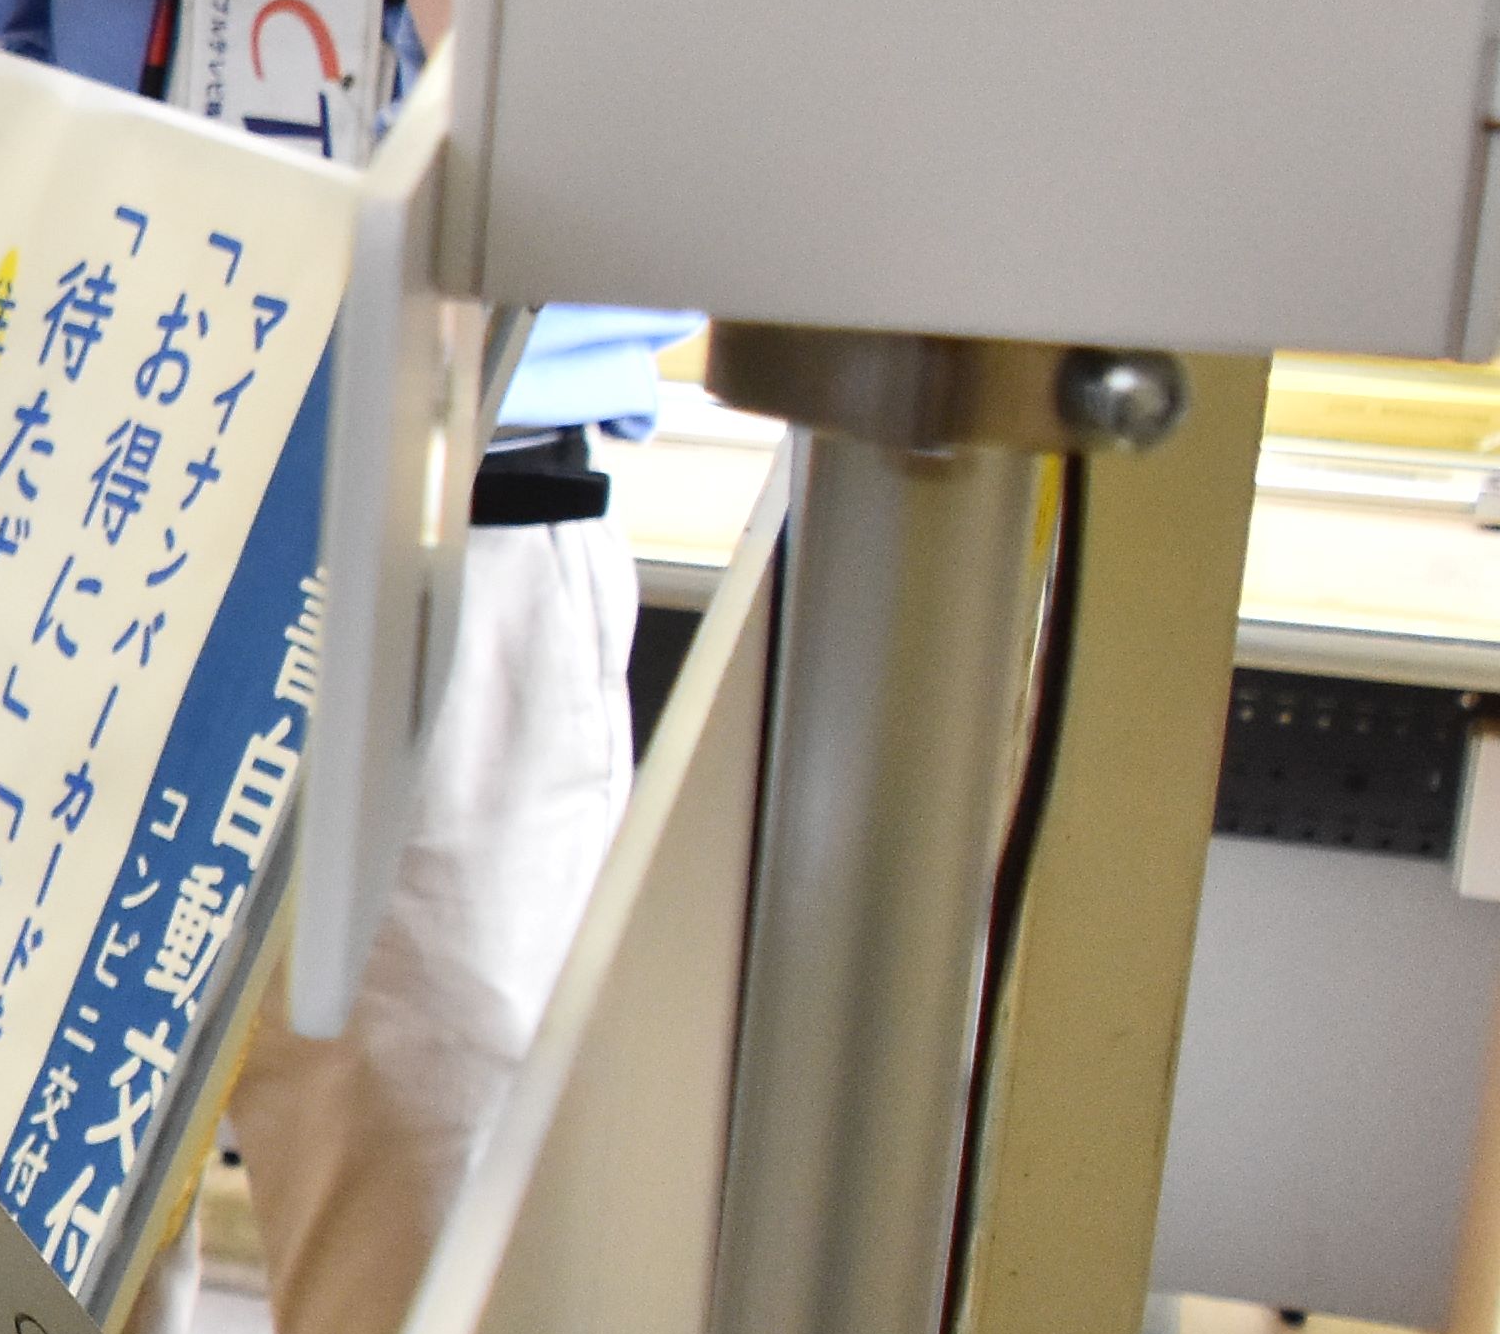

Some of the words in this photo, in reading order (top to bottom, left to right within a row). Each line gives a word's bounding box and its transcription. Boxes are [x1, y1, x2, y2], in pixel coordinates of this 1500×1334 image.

[4, 787, 190, 1223] コンビニ交付
